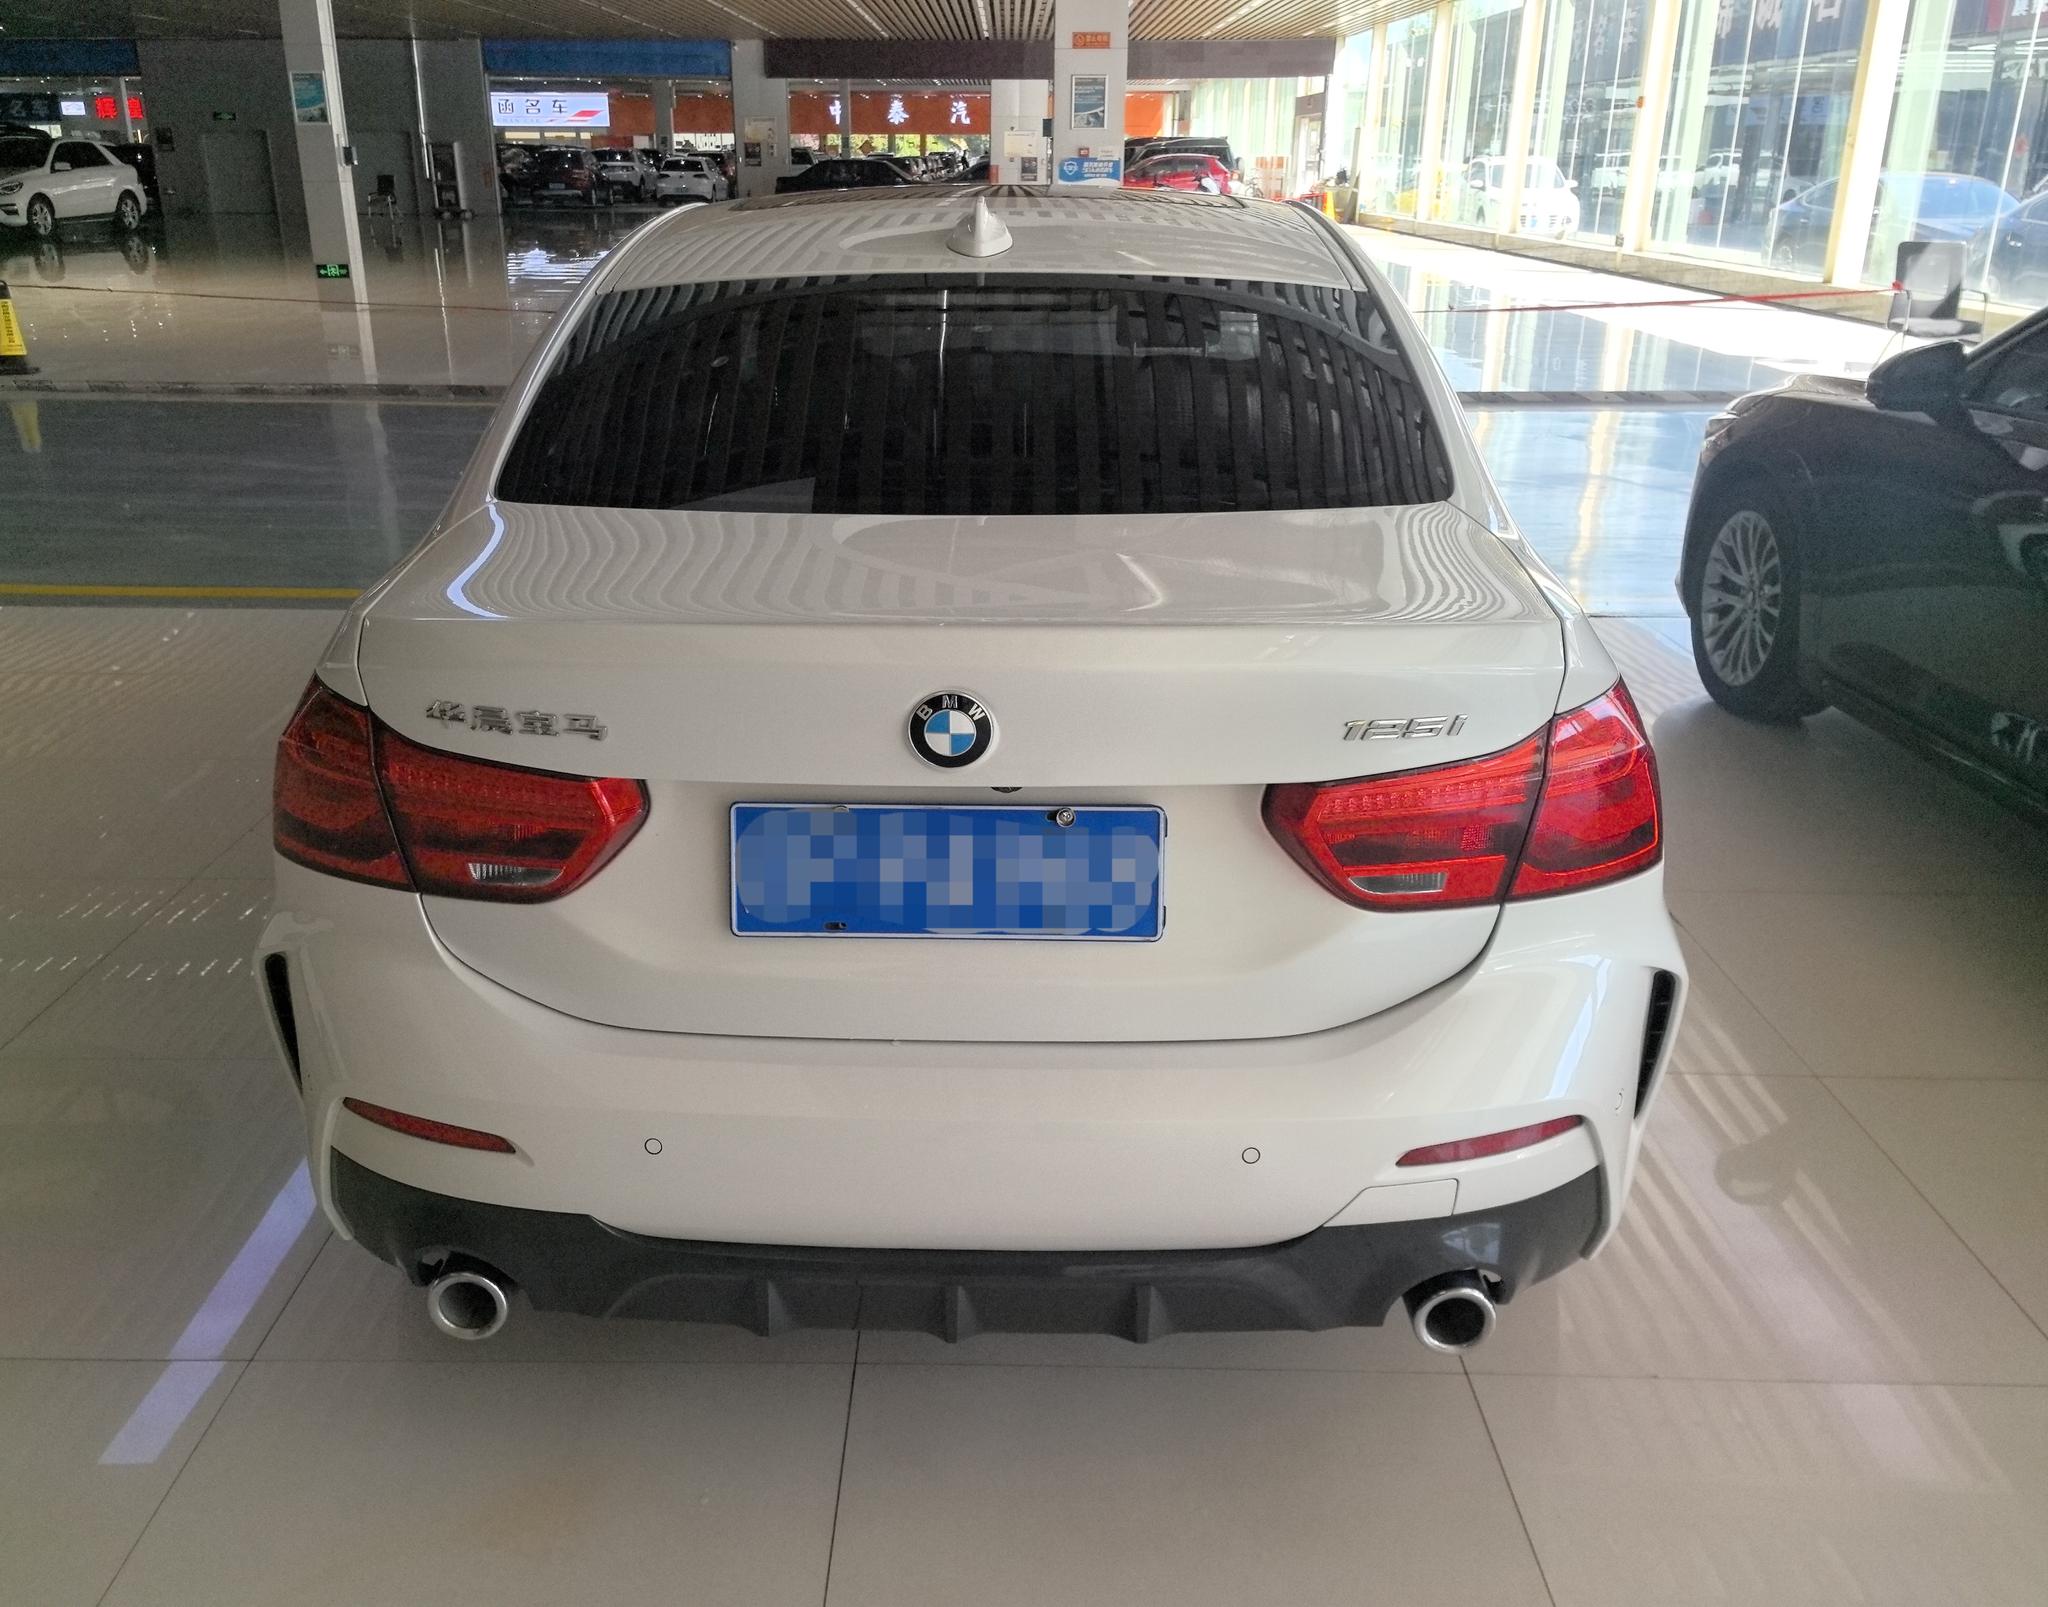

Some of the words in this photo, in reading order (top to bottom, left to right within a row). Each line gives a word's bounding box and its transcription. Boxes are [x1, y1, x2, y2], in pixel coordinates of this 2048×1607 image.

[426, 700, 609, 741] 华晨宝马
[916, 695, 986, 721] BMW
[1343, 714, 1469, 741] 125i
